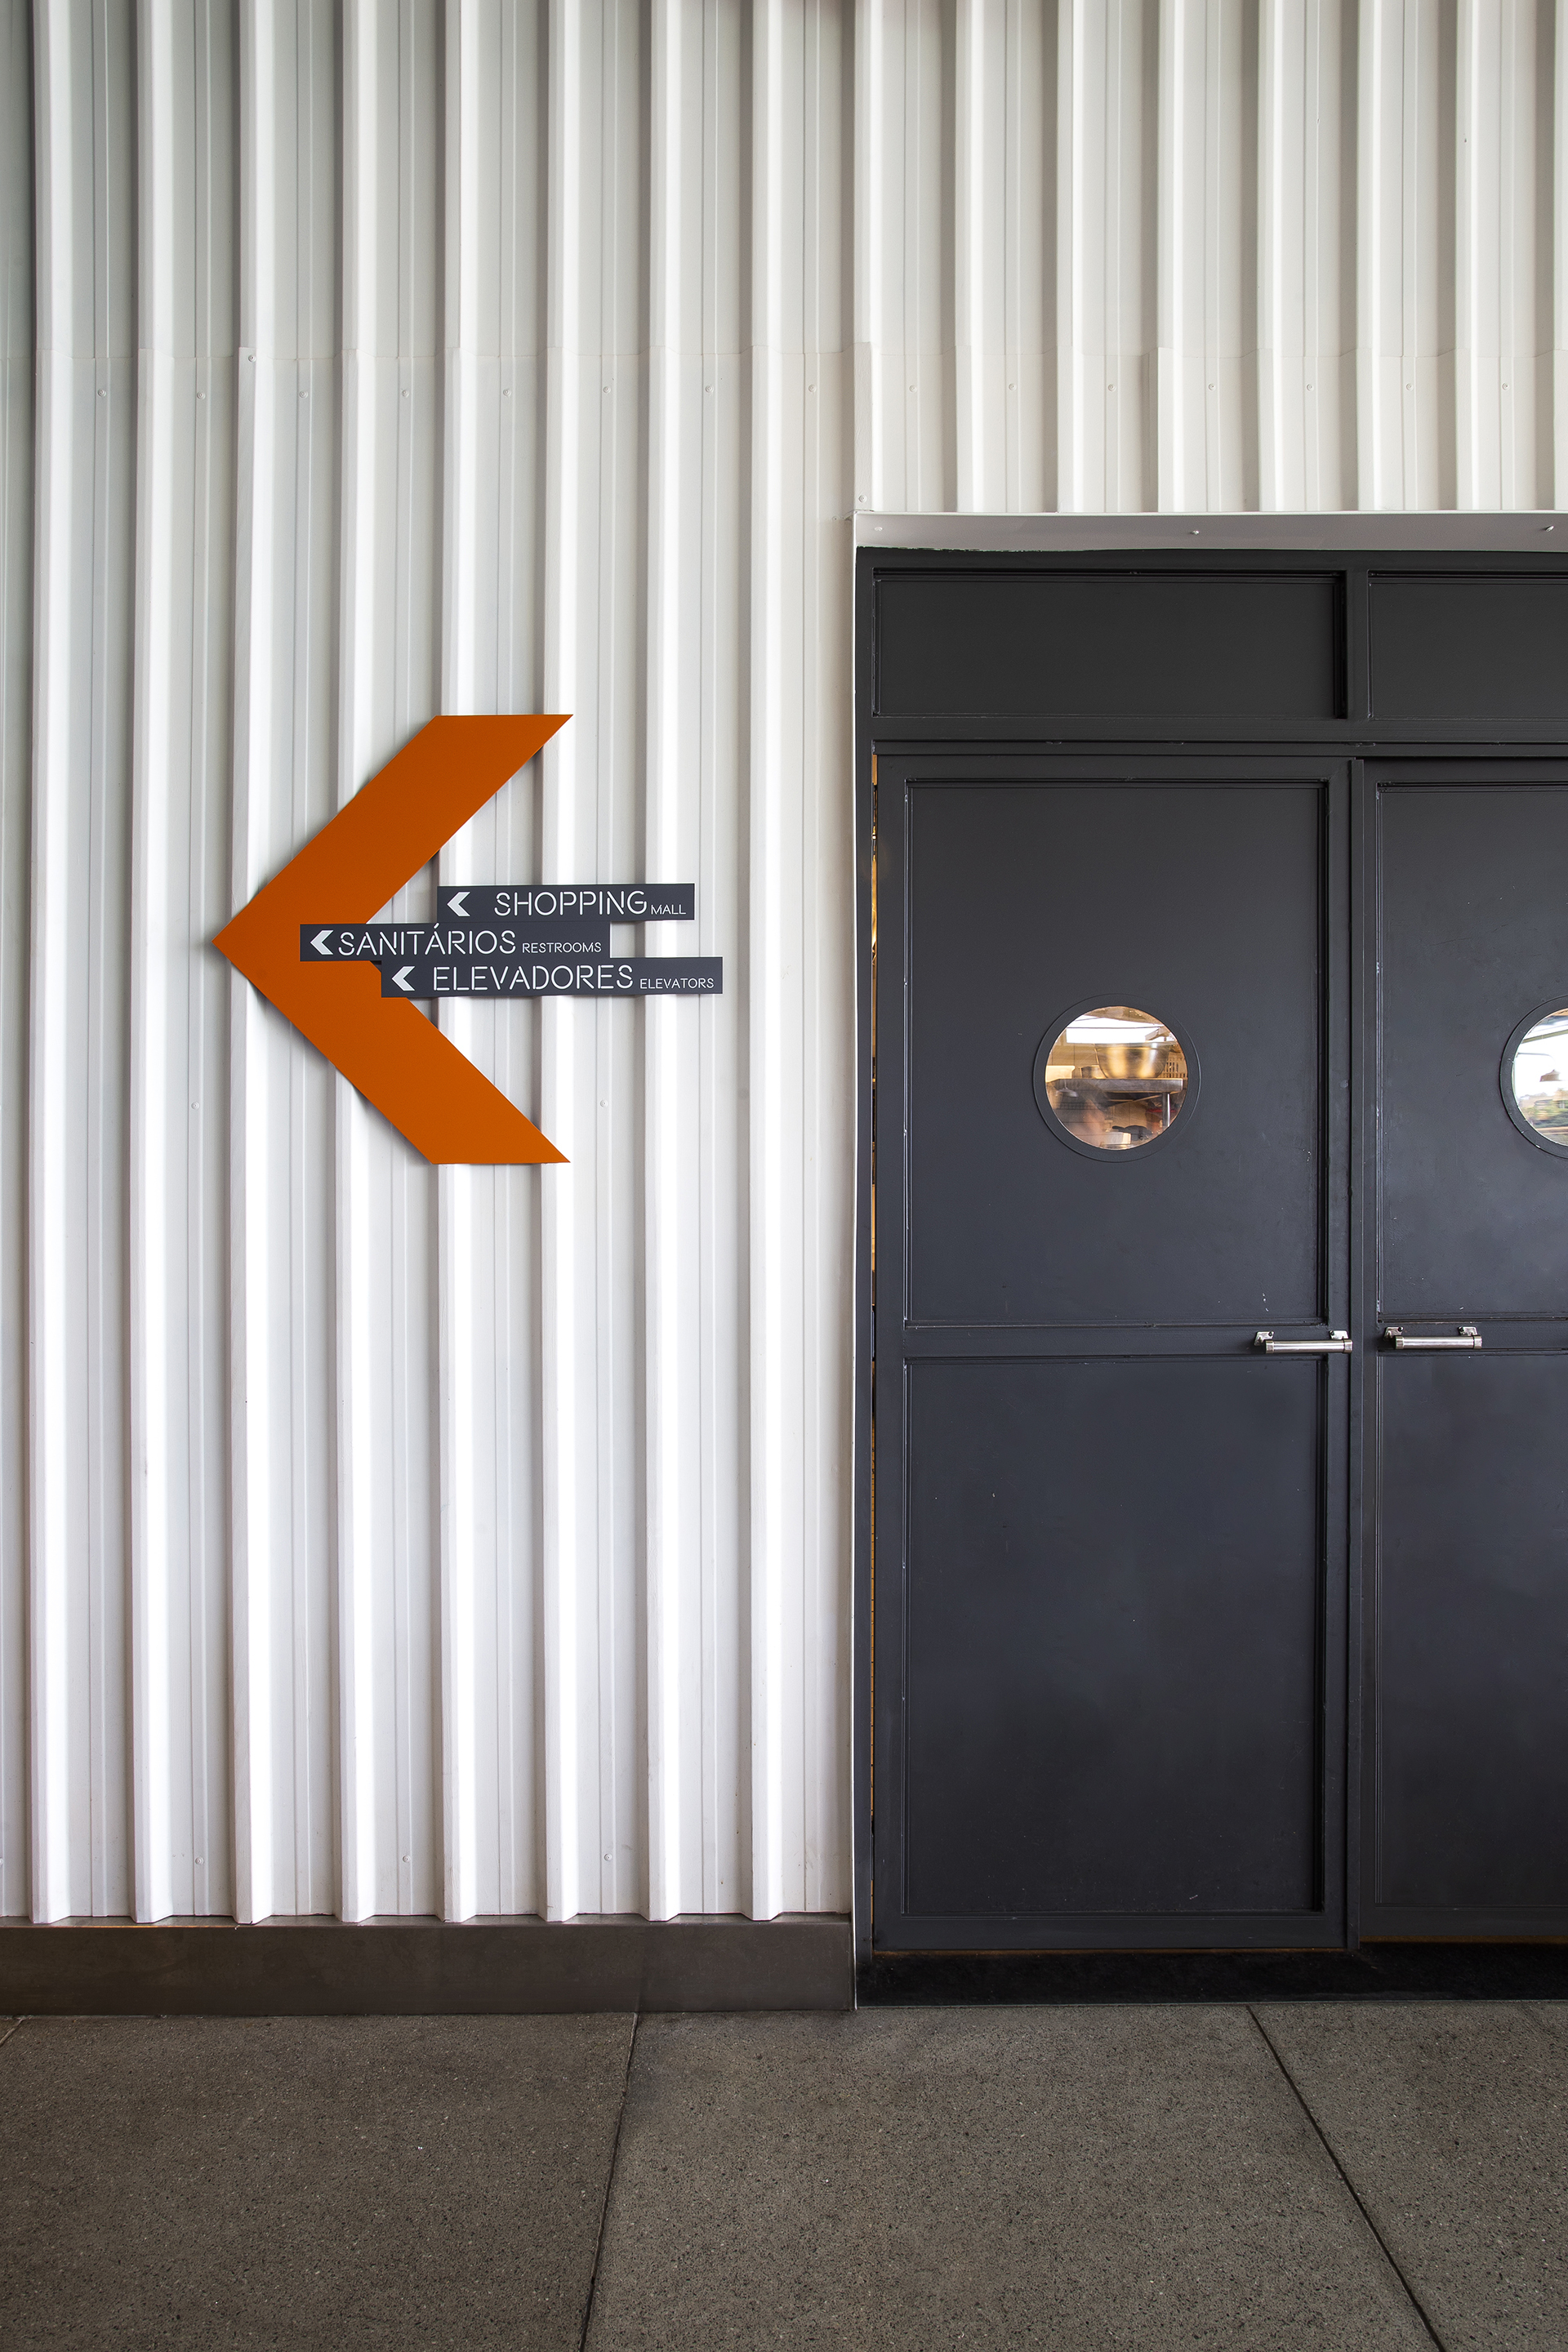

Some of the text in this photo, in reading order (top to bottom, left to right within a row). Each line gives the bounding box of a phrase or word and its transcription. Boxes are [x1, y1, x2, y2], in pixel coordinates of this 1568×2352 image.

[495, 891, 686, 915] SHOPPING MALL
[339, 923, 601, 956] SANITÁRIOS RESTROOMS
[434, 965, 714, 991] ELEVADORES ELEVATORS
